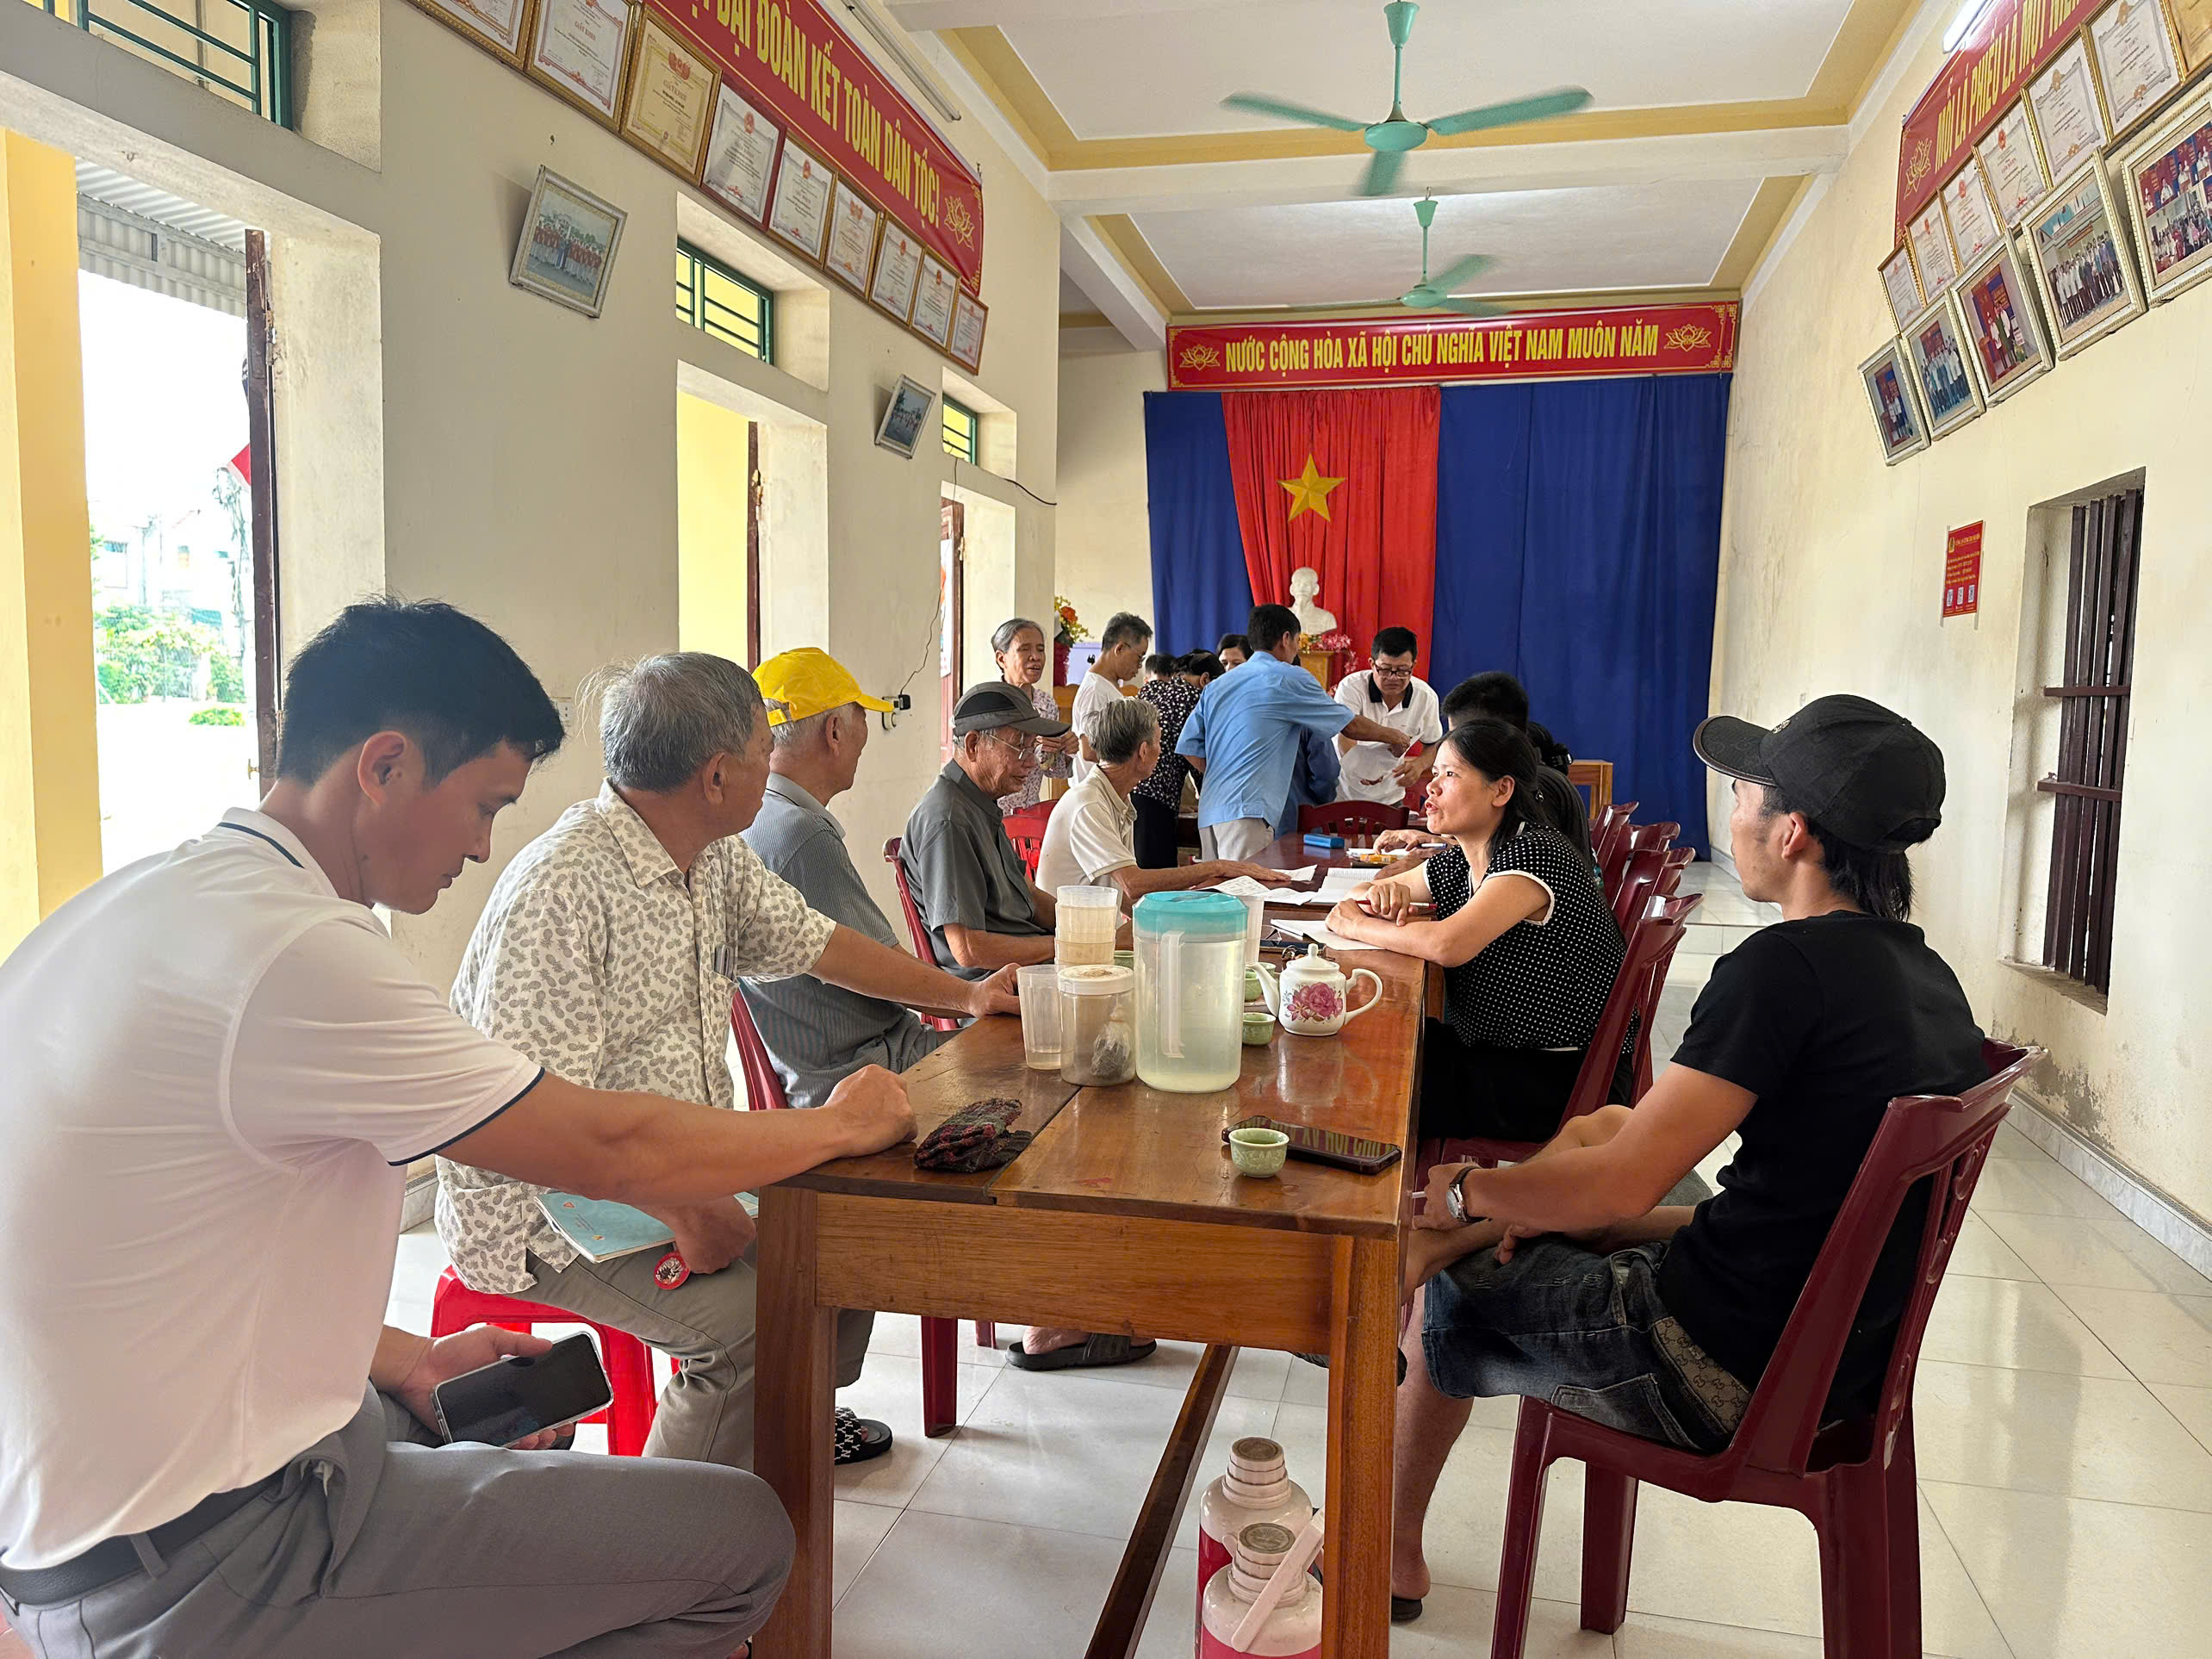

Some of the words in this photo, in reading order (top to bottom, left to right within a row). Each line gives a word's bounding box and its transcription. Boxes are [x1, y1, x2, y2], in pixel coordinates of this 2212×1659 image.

[757, 0, 807, 102] ĐOÀN
[811, 40, 841, 132] KẾT
[843, 77, 881, 173] TOÀN
[884, 119, 911, 201] DÂN
[913, 147, 940, 228] TỘC!
[1954, 62, 1969, 151] LÁ
[1226, 334, 1265, 372] NƯỚC
[1270, 333, 1309, 377] CỘNG
[1314, 331, 1344, 370] HÒA
[1347, 331, 1368, 368] XÃ
[1372, 329, 1397, 373] HỘI
[1401, 324, 1432, 365] CHỦ
[1437, 326, 1484, 363] NGHĨA
[1489, 324, 1522, 368] VIỆT
[1525, 328, 1563, 361] NAM
[1567, 320, 1616, 359] MUÔN
[1620, 318, 1659, 357] NĂM
